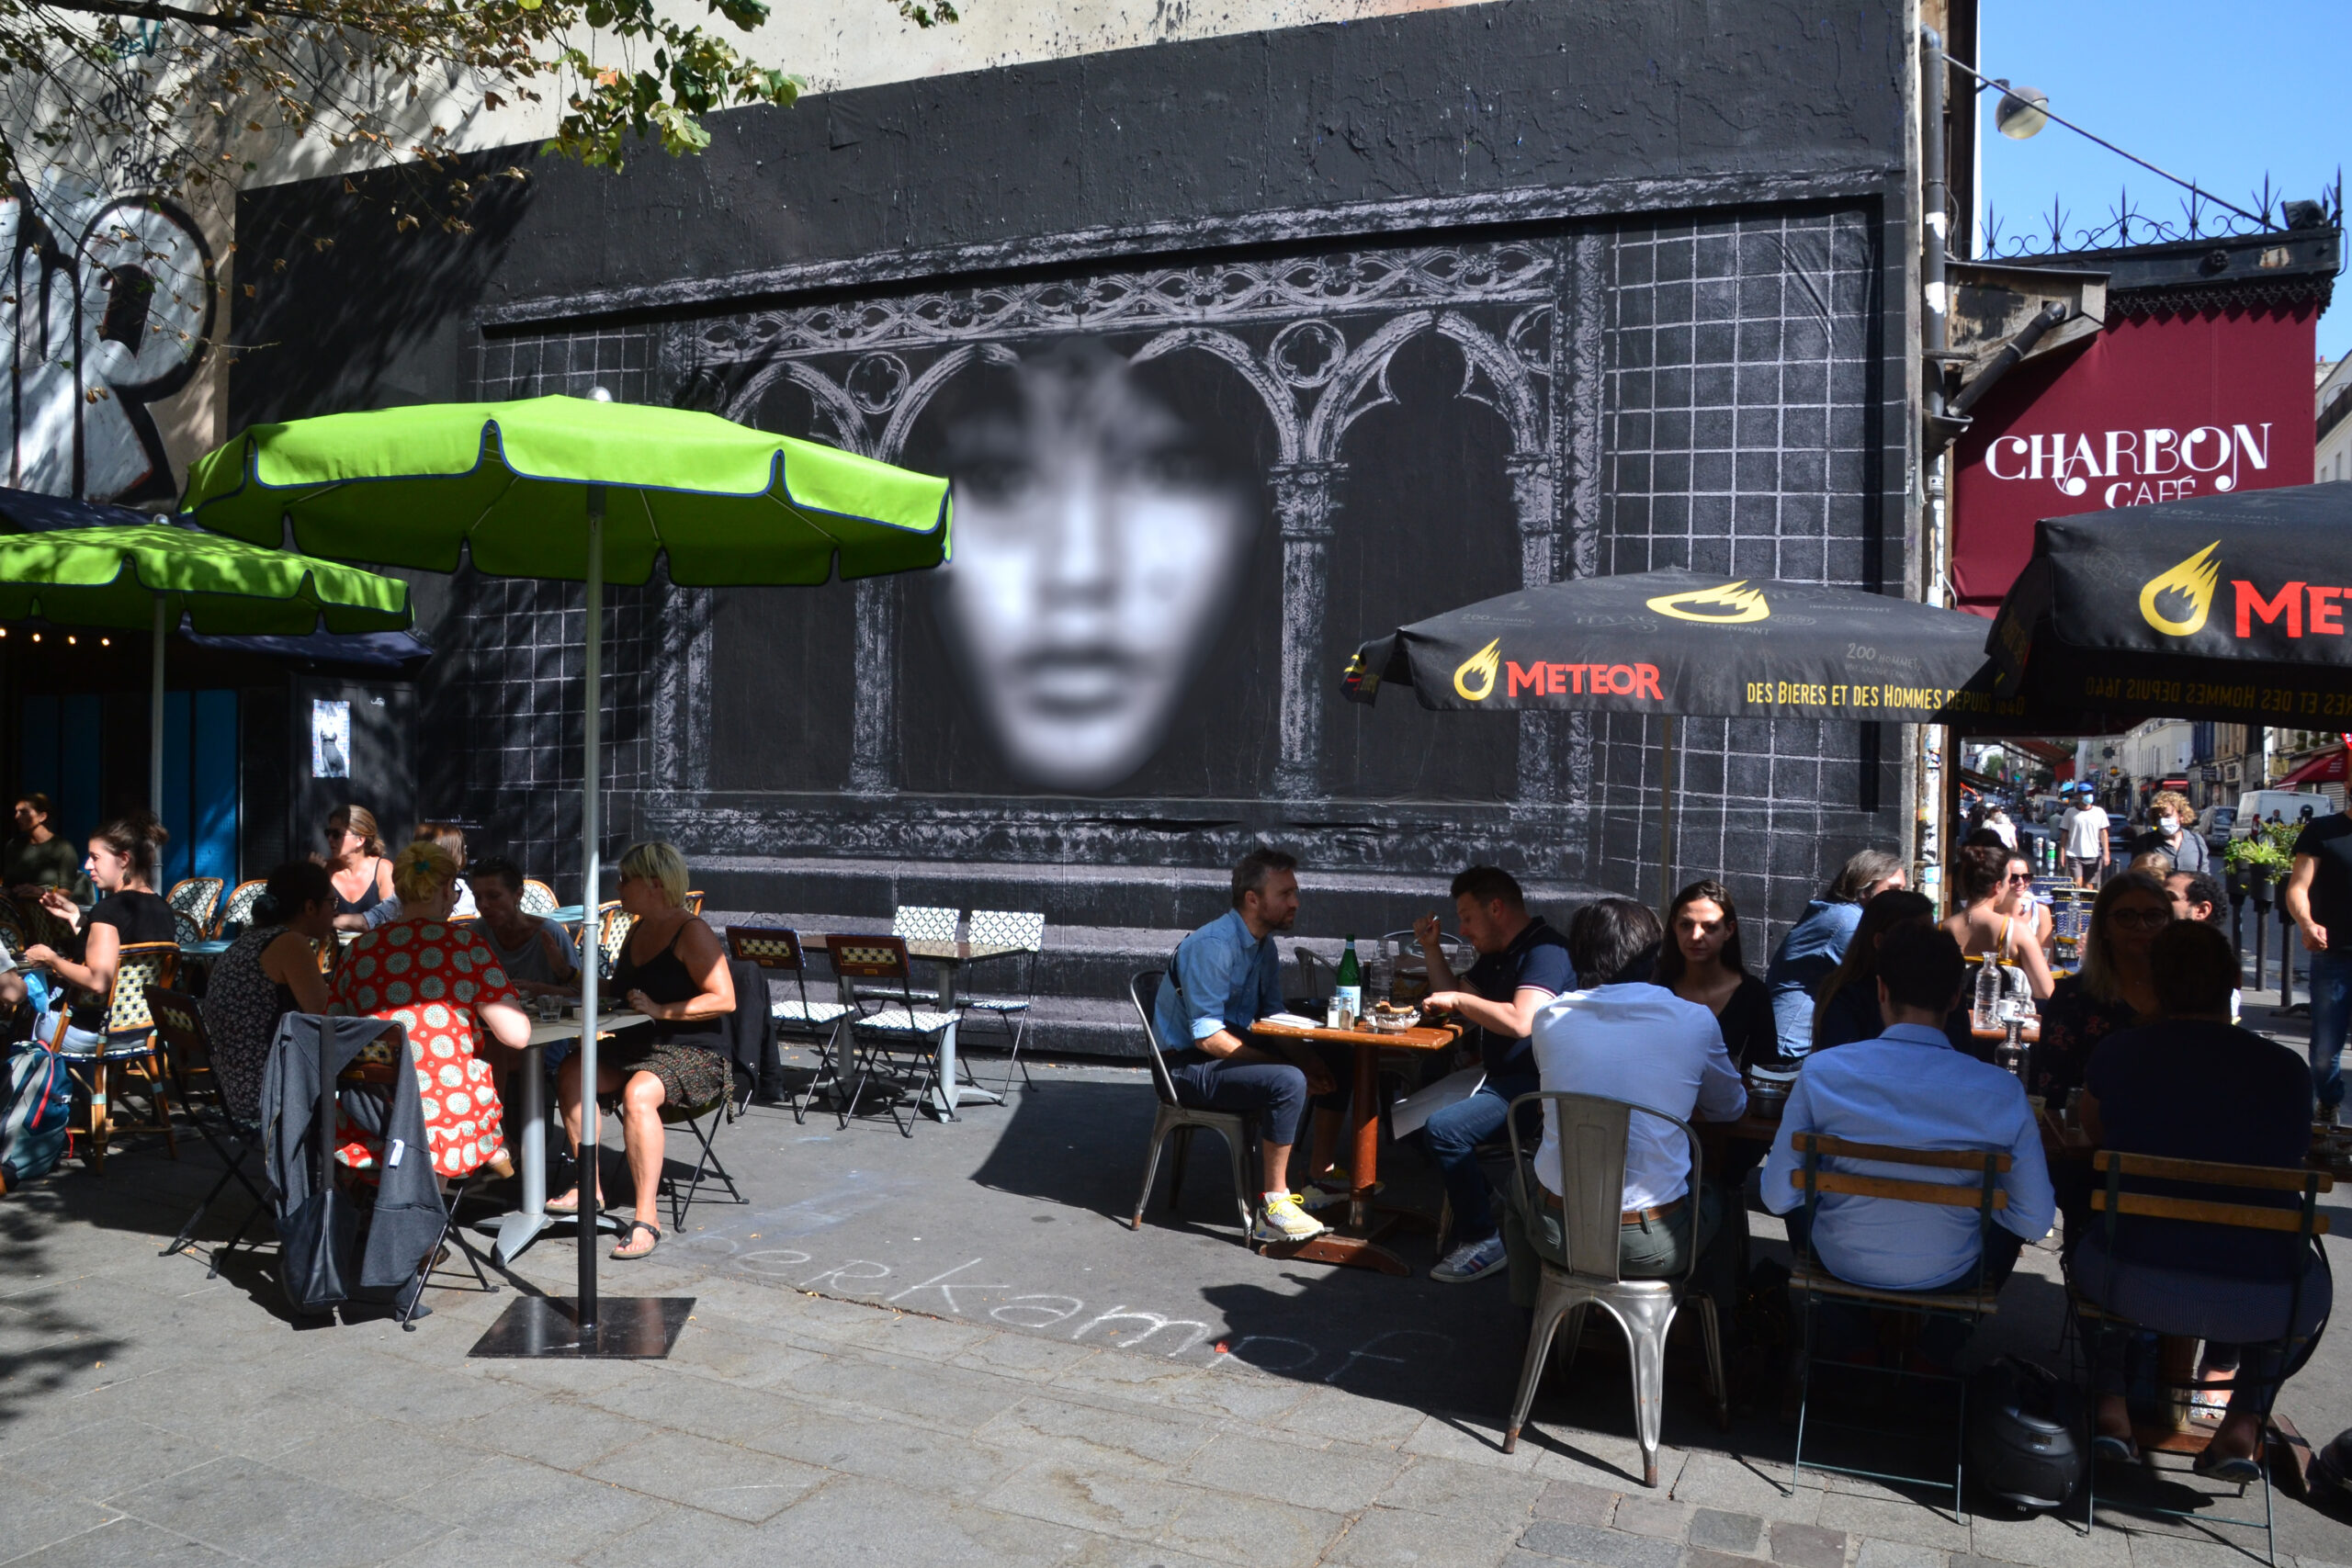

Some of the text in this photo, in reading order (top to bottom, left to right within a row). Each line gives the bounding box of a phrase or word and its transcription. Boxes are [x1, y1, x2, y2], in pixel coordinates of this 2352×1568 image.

[1985, 423, 2272, 496] CHARBON
[2105, 475, 2196, 508] CAFÉ
[2231, 580, 2352, 638] ME
[1847, 642, 1875, 660] 200
[1505, 660, 1665, 700] METEOR
[1747, 682, 1773, 704] DES
[1778, 681, 1826, 706] BIERES
[1831, 685, 1849, 705] ET
[1853, 686, 1879, 706] DES
[1883, 684, 1942, 710] HOMMES
